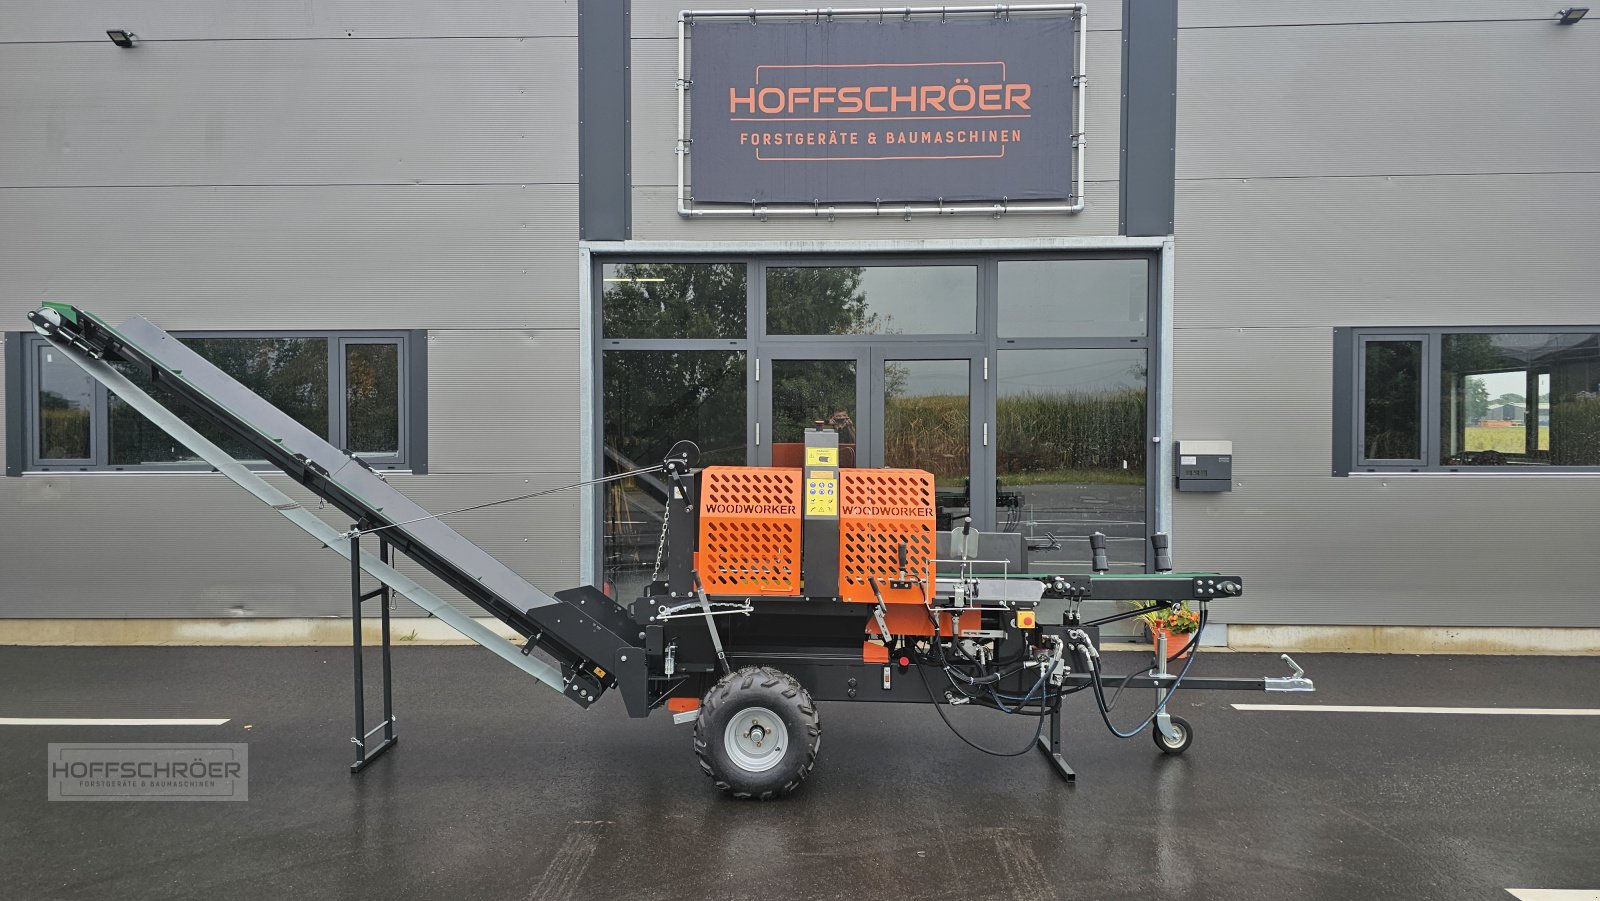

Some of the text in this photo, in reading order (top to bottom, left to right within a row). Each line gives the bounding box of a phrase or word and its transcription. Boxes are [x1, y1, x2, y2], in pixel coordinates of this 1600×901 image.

[730, 78, 1032, 113] HOFFSCHRÖER
[740, 129, 1022, 146] FORSTGERÄTE & BAUMASCHINEN
[706, 504, 796, 515] WOODWORKER
[842, 506, 934, 517] WOODWORKER
